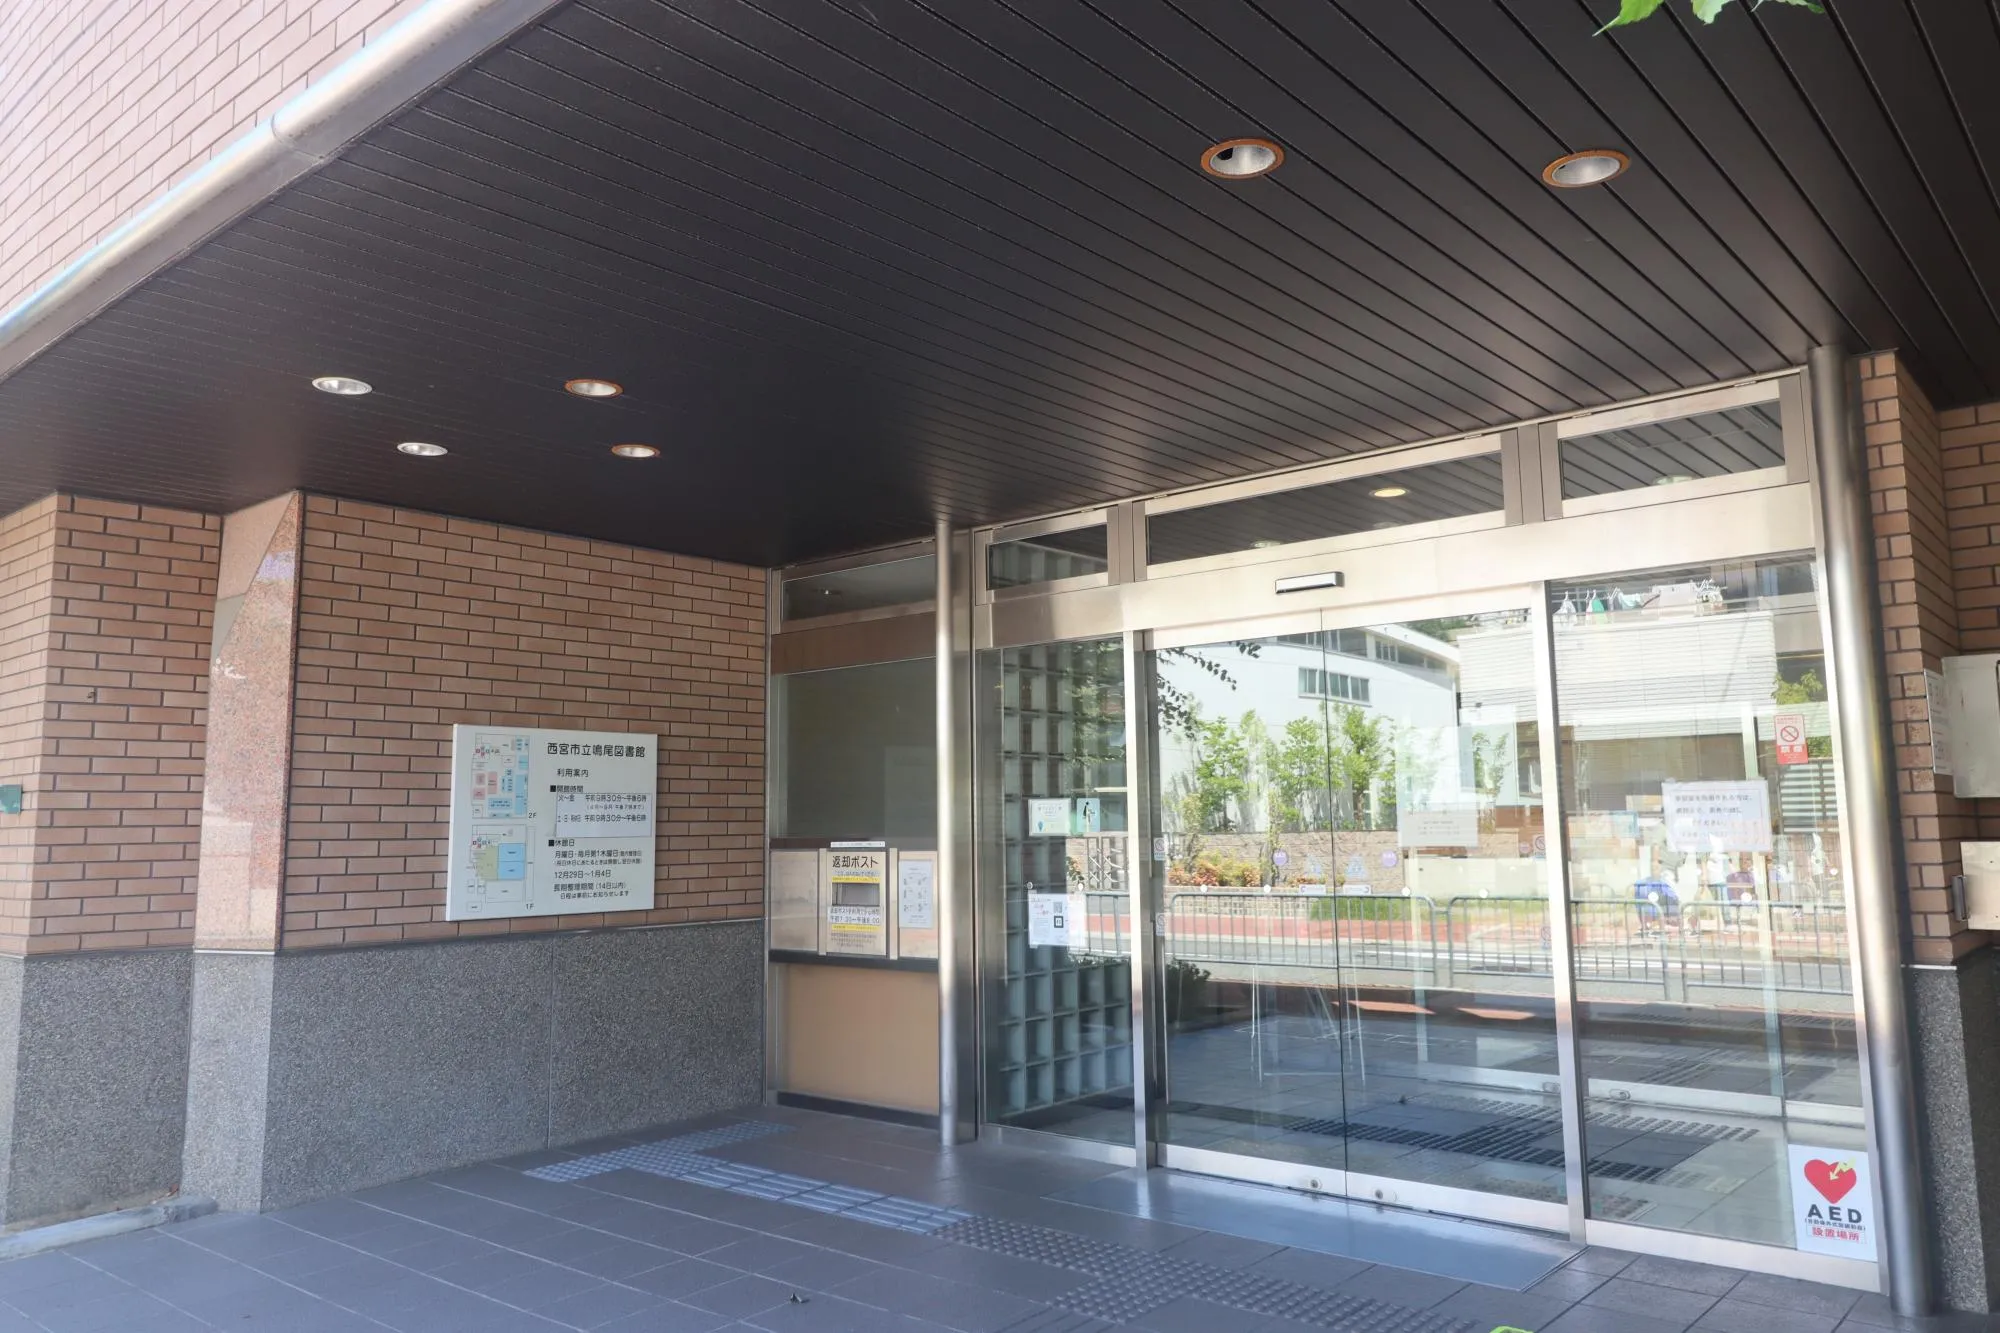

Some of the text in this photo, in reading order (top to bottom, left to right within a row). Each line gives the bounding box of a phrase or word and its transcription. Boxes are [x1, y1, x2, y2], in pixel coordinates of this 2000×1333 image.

[547, 742, 646, 758] 西宮市立鳴尾図書館
[557, 768, 589, 778] 利用案内
[832, 855, 879, 868] 返却ポスト
[1807, 1203, 1862, 1224] AED
[1812, 1227, 1860, 1241] 設置場所
